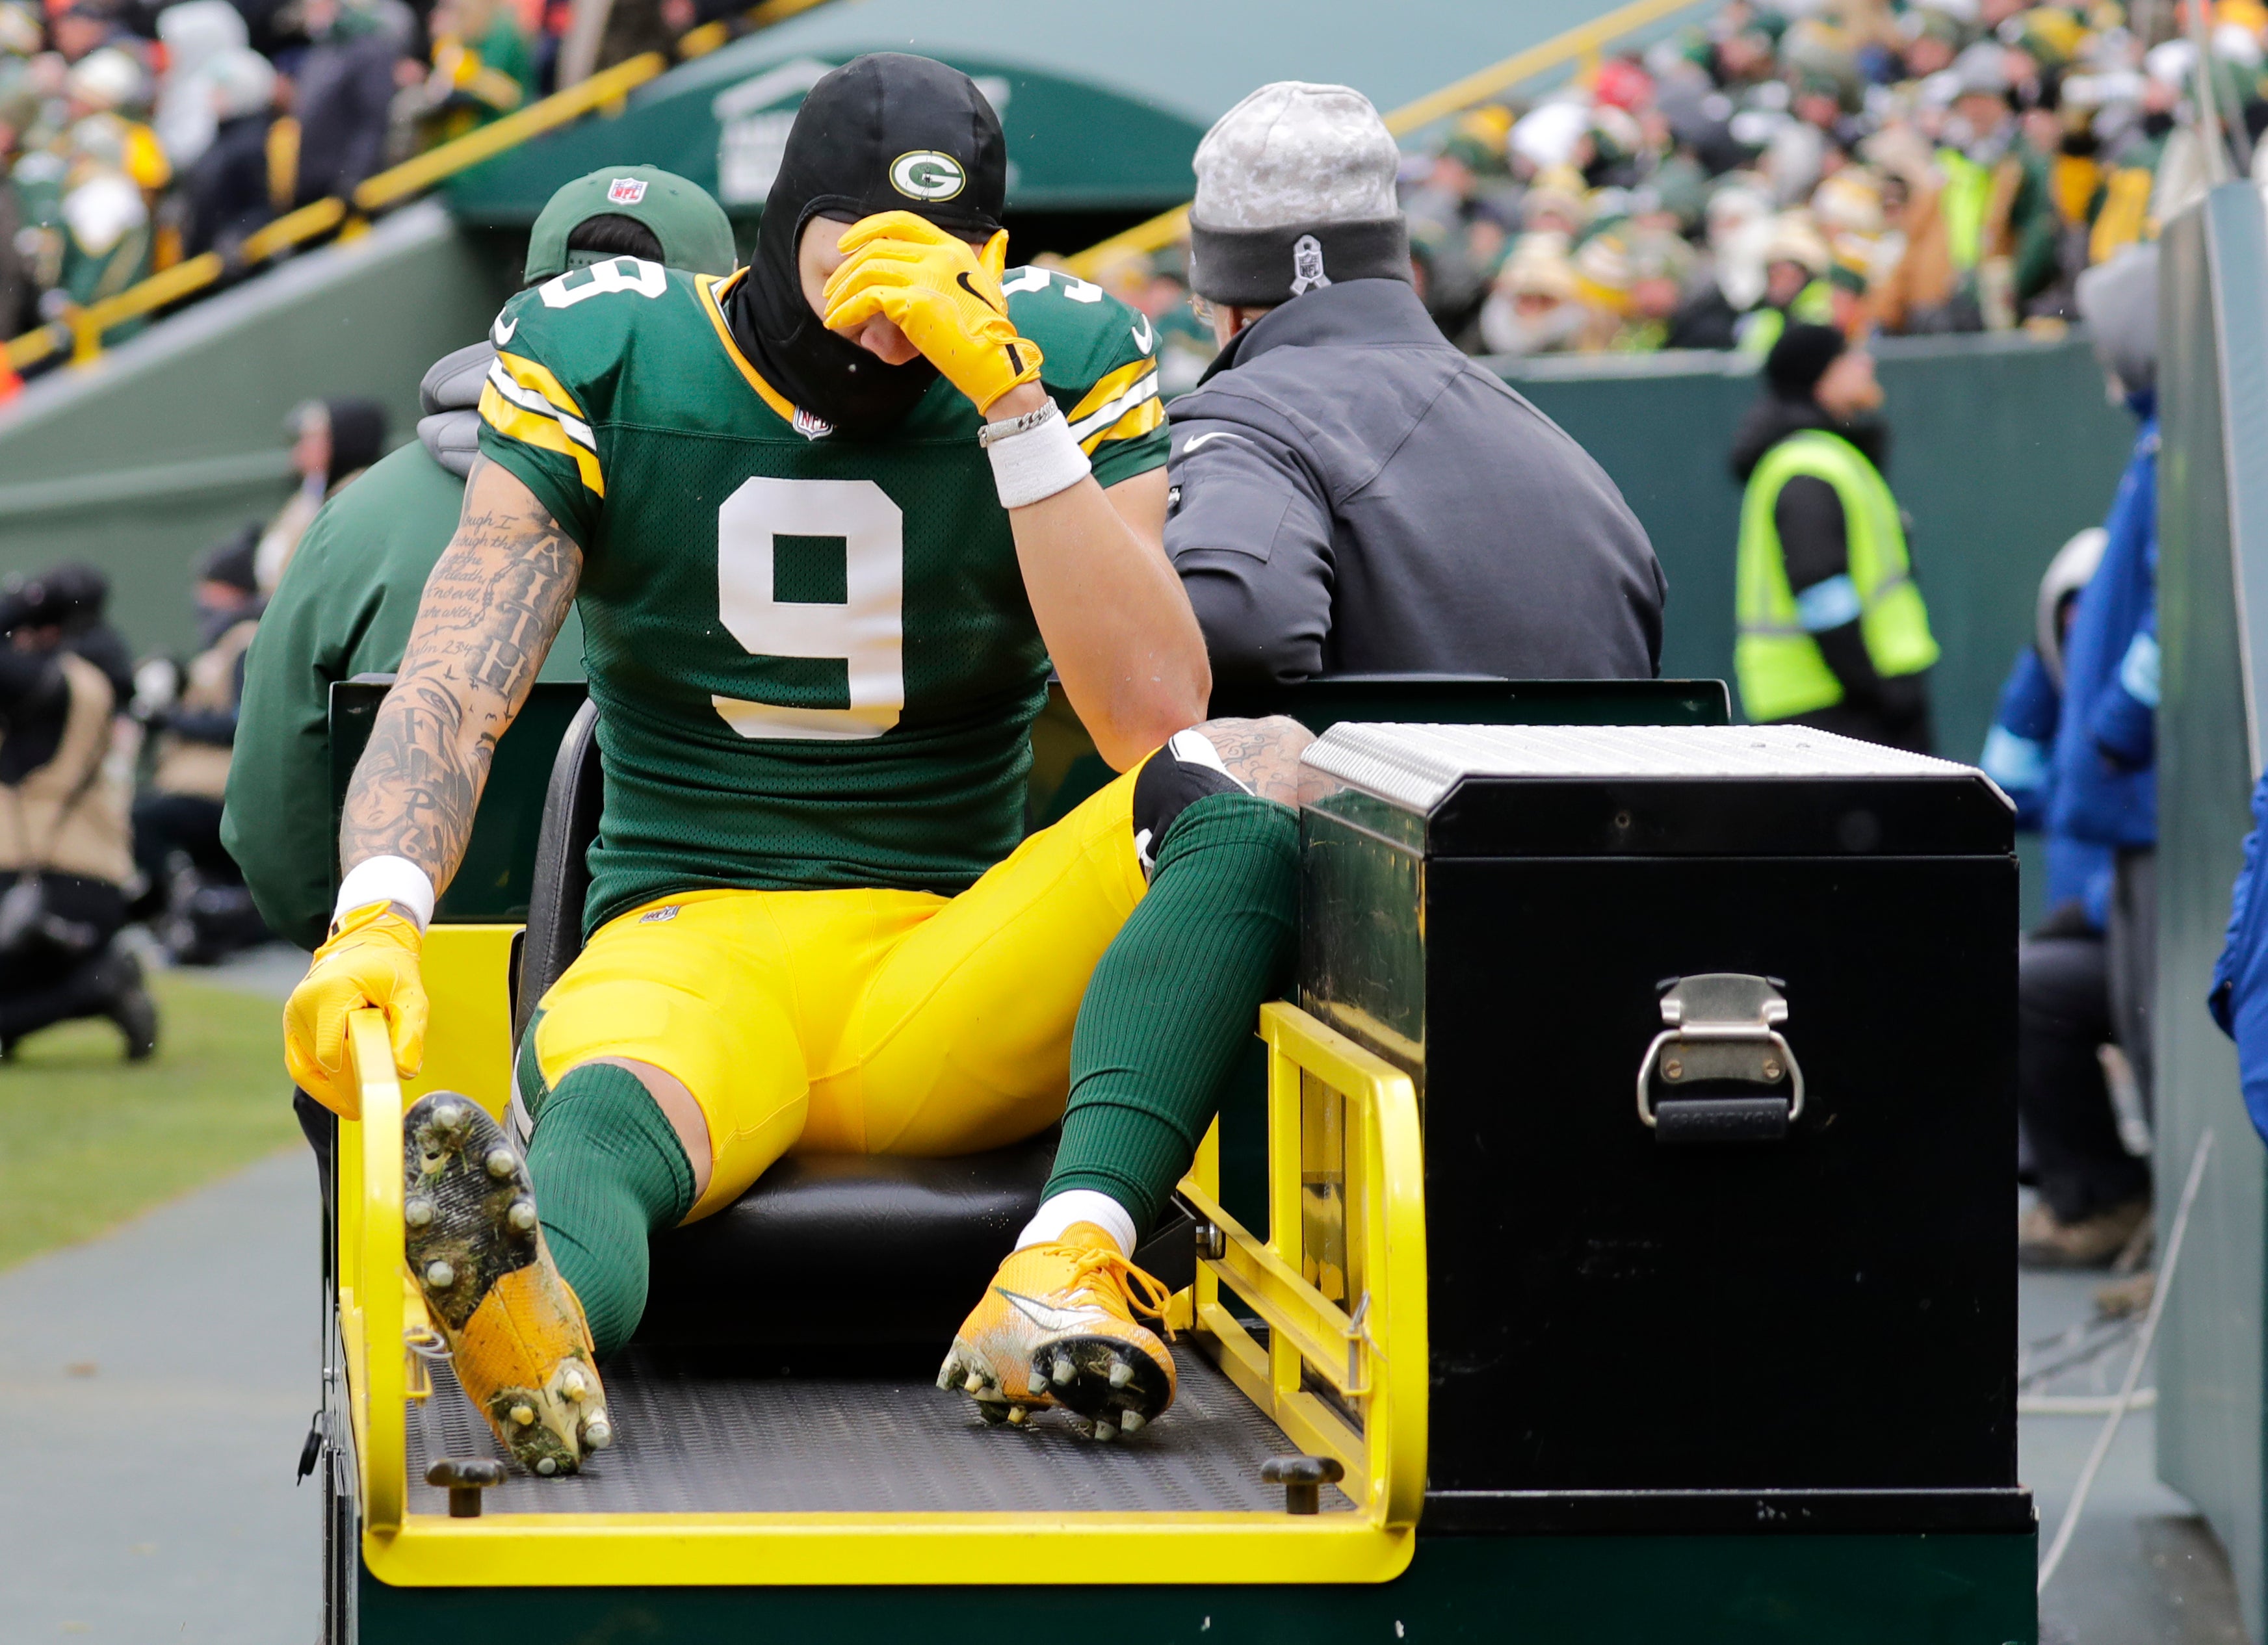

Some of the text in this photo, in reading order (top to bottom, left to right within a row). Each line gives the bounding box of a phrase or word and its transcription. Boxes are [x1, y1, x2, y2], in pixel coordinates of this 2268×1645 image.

[894, 154, 962, 198] G
[614, 187, 639, 200] NFL
[1301, 264, 1320, 278] NFL
[800, 409, 829, 431] NFL
[711, 476, 905, 740] 9
